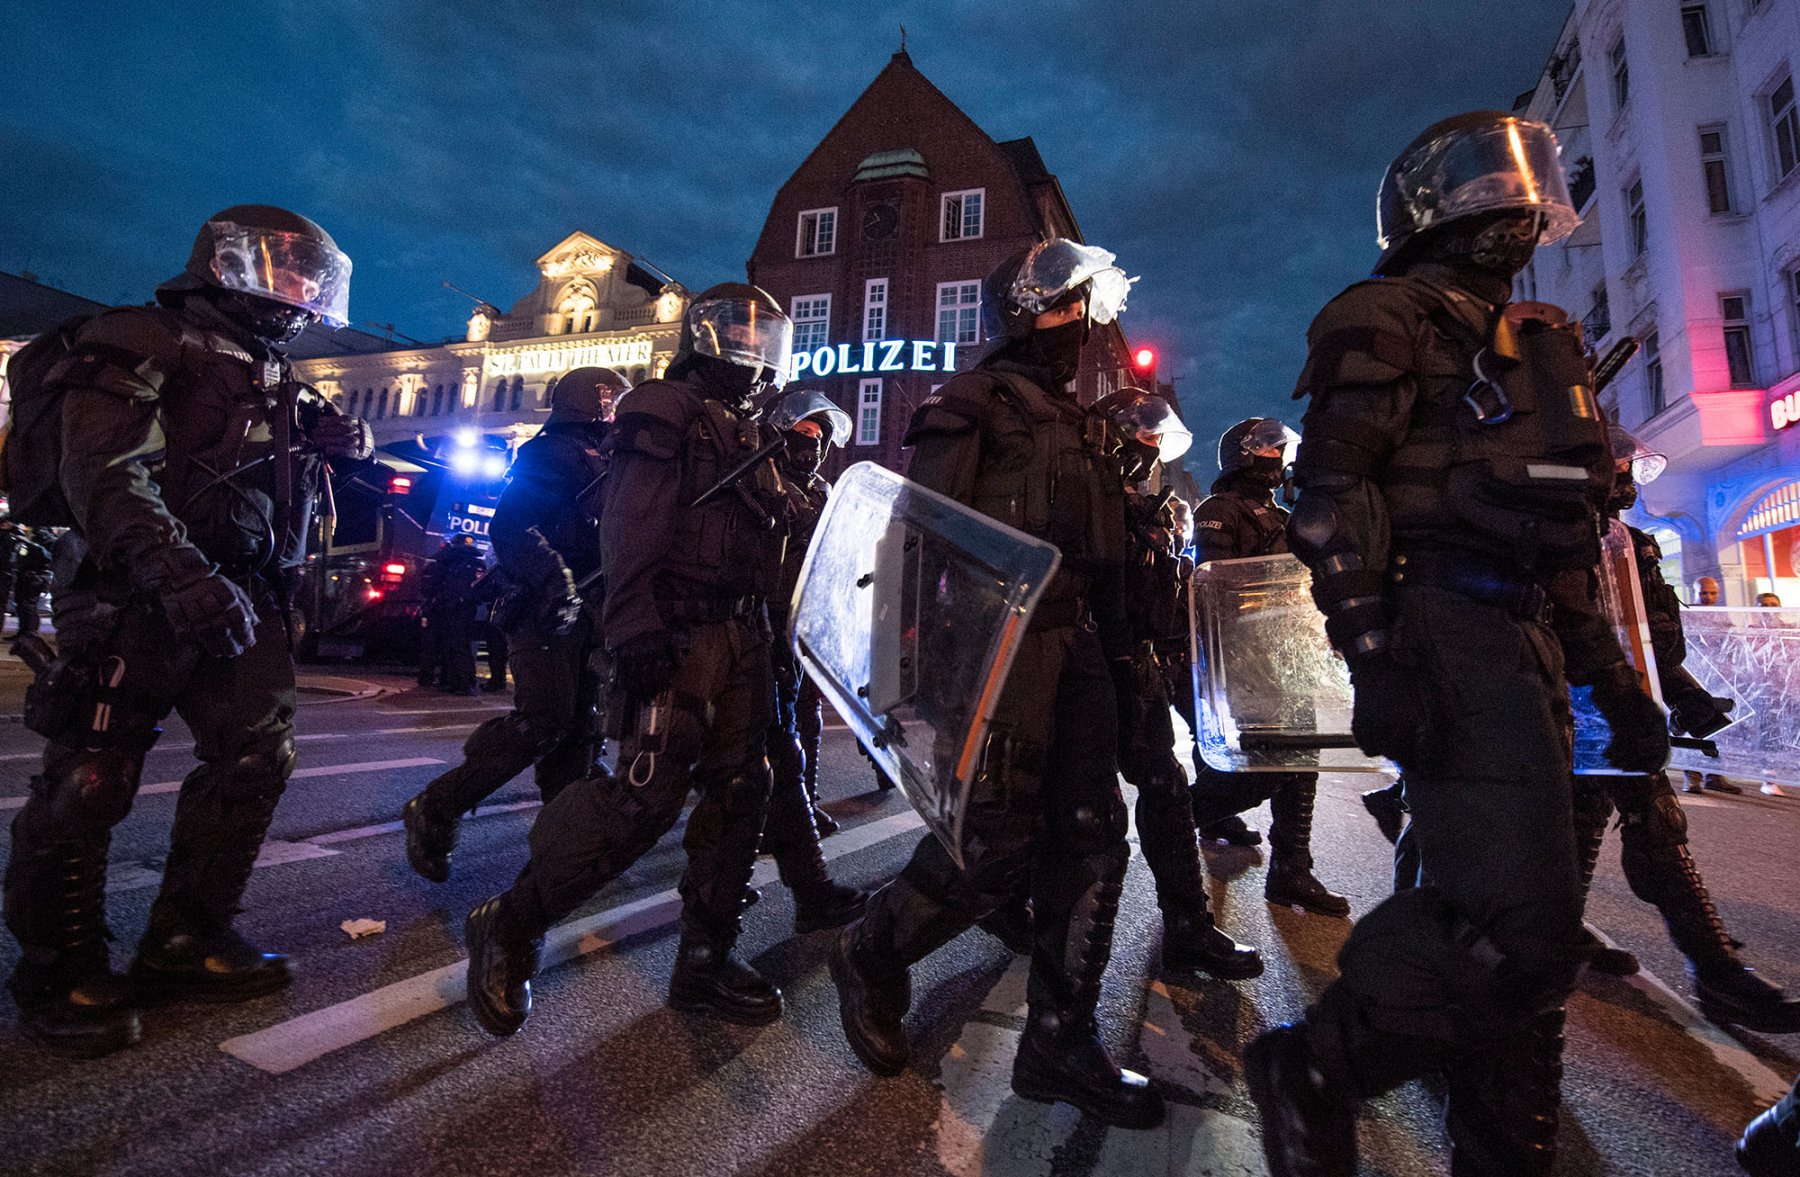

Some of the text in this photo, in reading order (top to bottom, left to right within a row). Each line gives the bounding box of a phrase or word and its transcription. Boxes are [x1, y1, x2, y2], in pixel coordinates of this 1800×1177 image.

[790, 340, 957, 382] POLIZEI
[1770, 390, 1800, 430] BU
[449, 516, 490, 536] POLI
